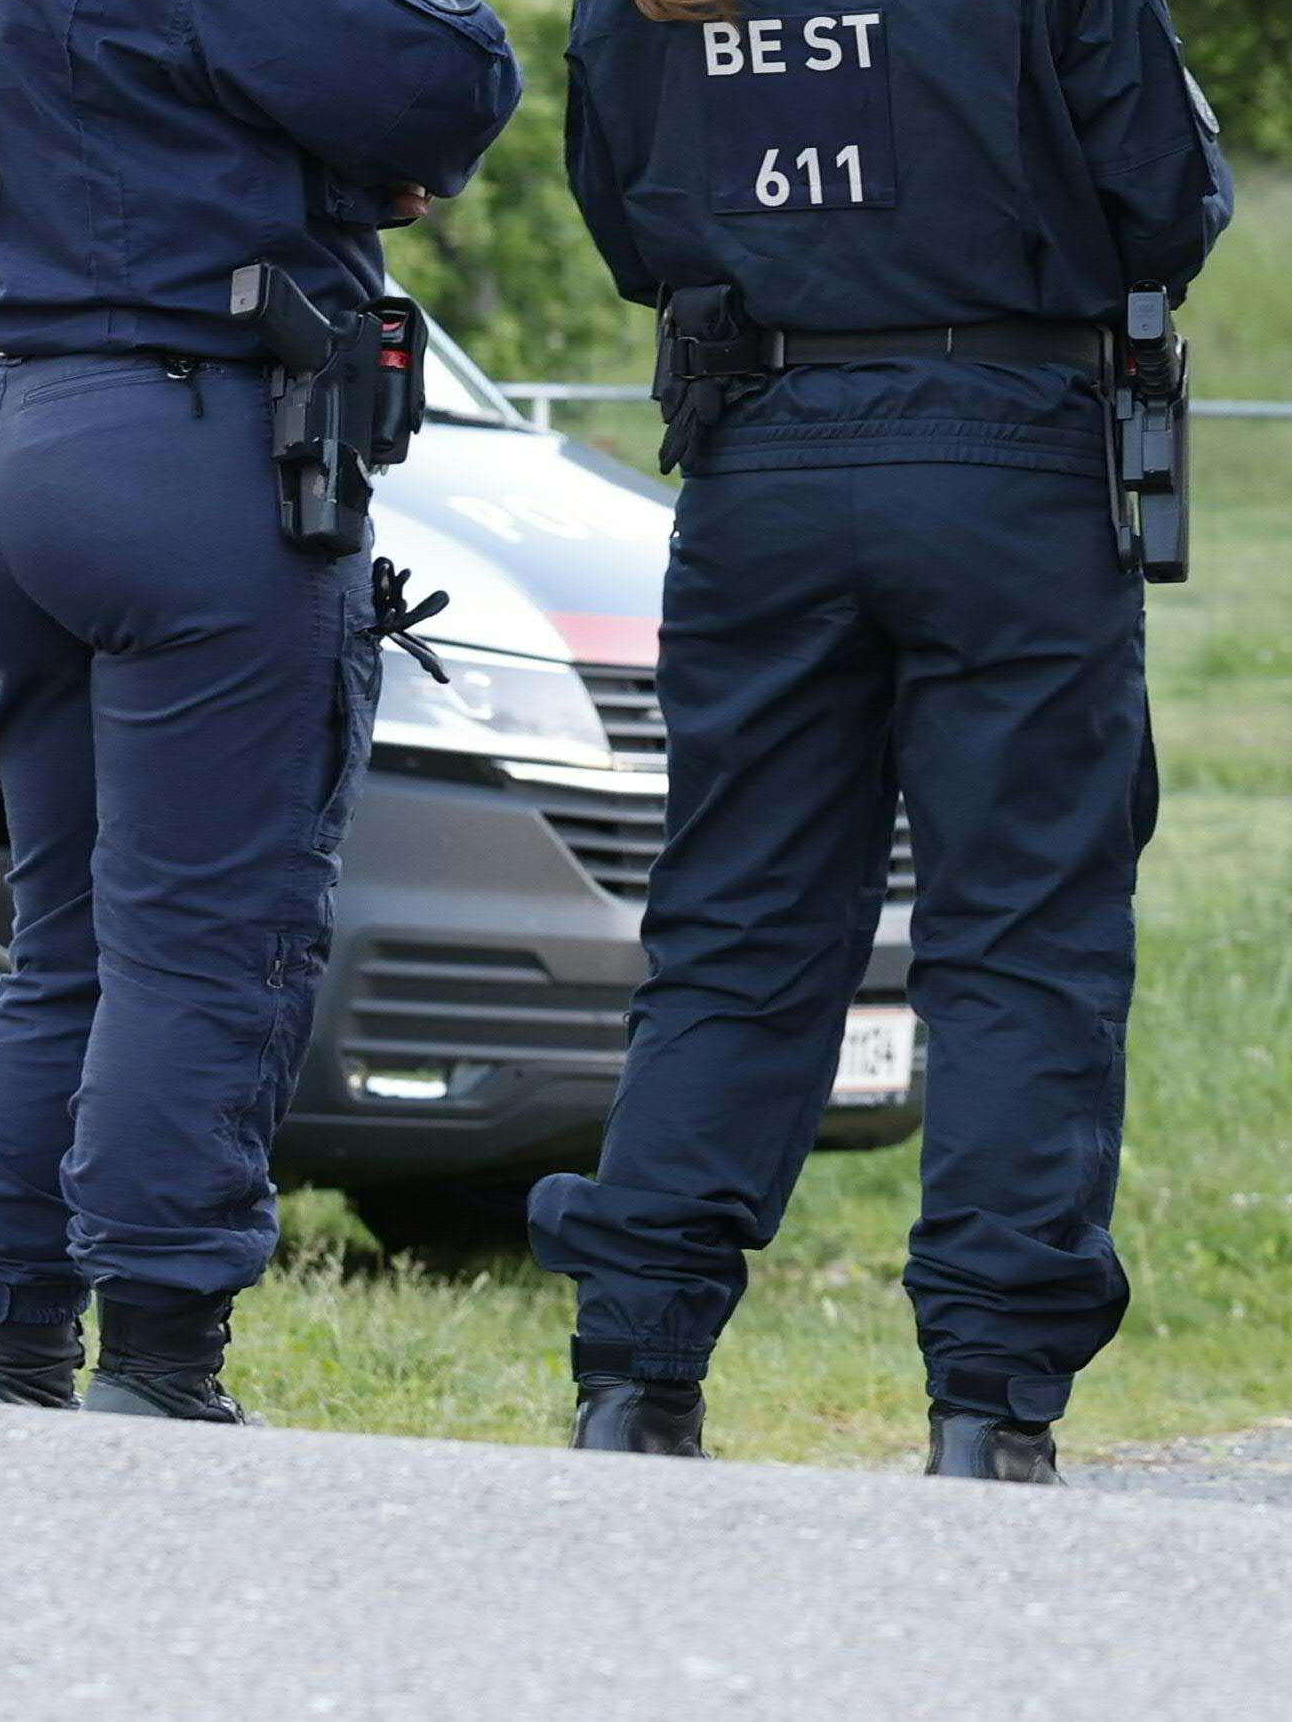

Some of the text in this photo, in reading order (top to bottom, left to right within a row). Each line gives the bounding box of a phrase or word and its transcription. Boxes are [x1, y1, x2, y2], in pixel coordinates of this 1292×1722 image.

[703, 13, 880, 76] BE ST
[755, 144, 864, 207] 611
